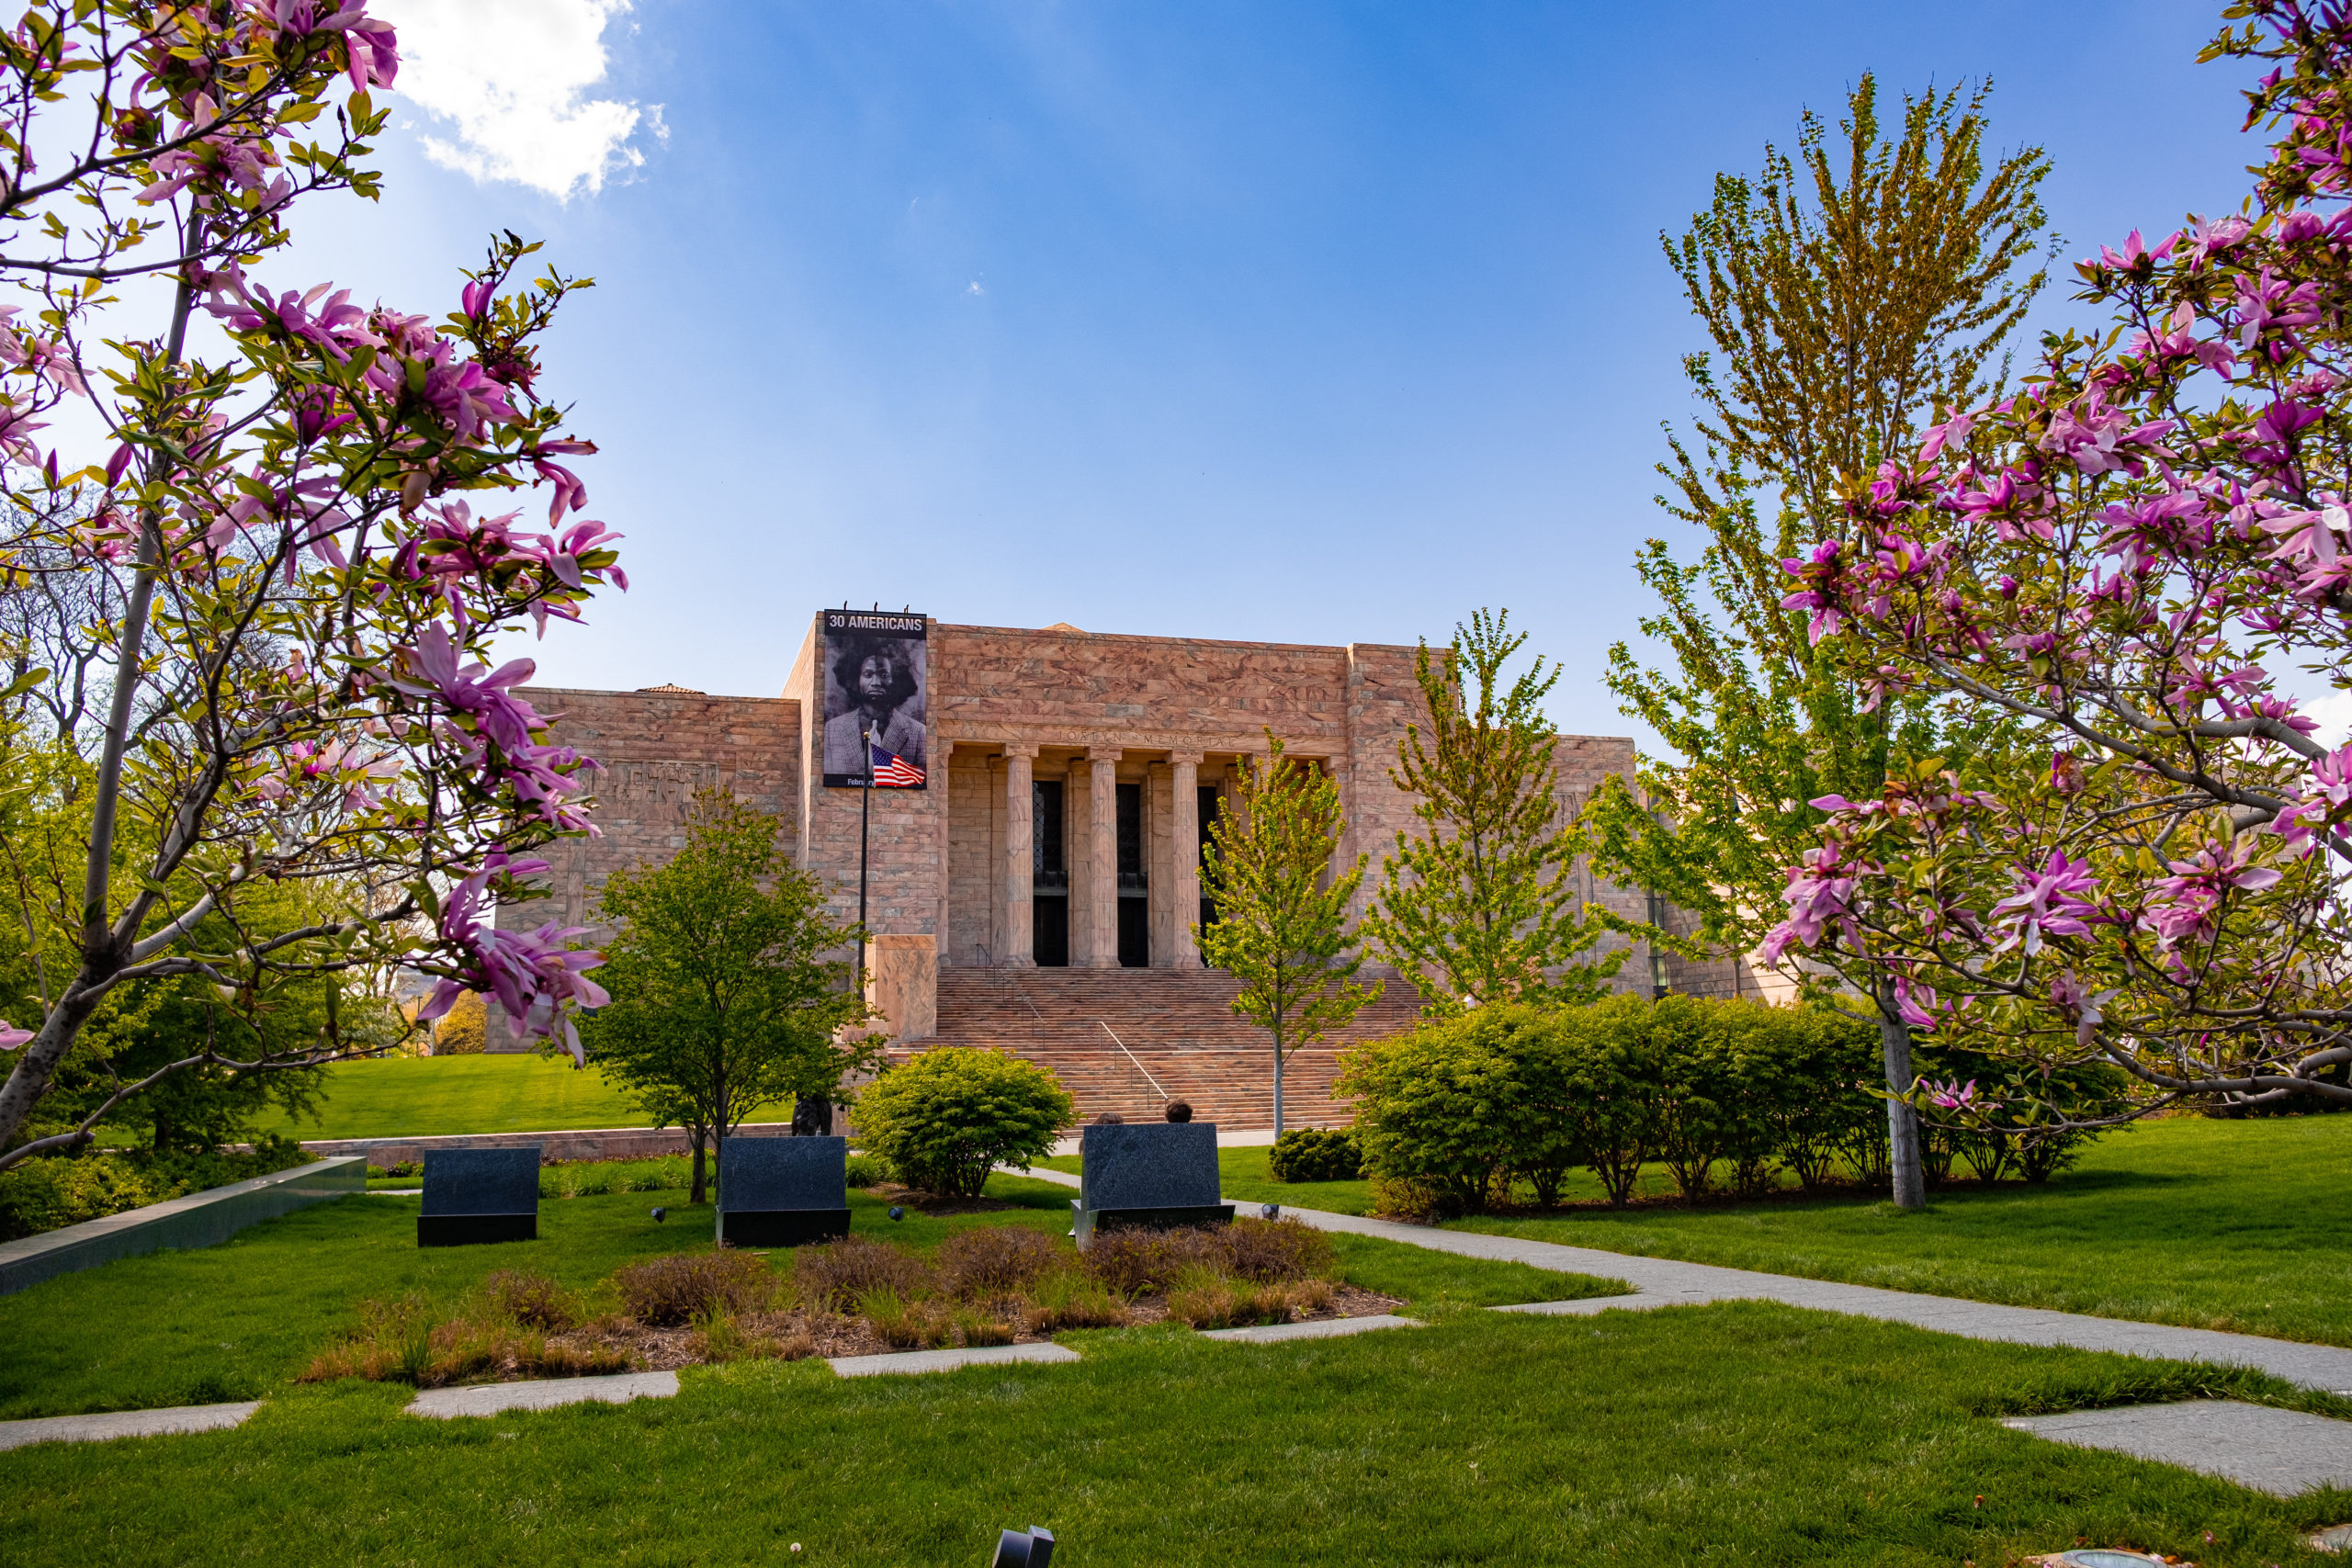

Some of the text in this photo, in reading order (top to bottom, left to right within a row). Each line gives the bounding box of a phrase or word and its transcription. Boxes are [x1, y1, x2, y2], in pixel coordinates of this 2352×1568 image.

[830, 615, 922, 631] 30 AMERICANS
[1144, 734, 1235, 747] MEMORIAL
[847, 778, 875, 787] Februry
